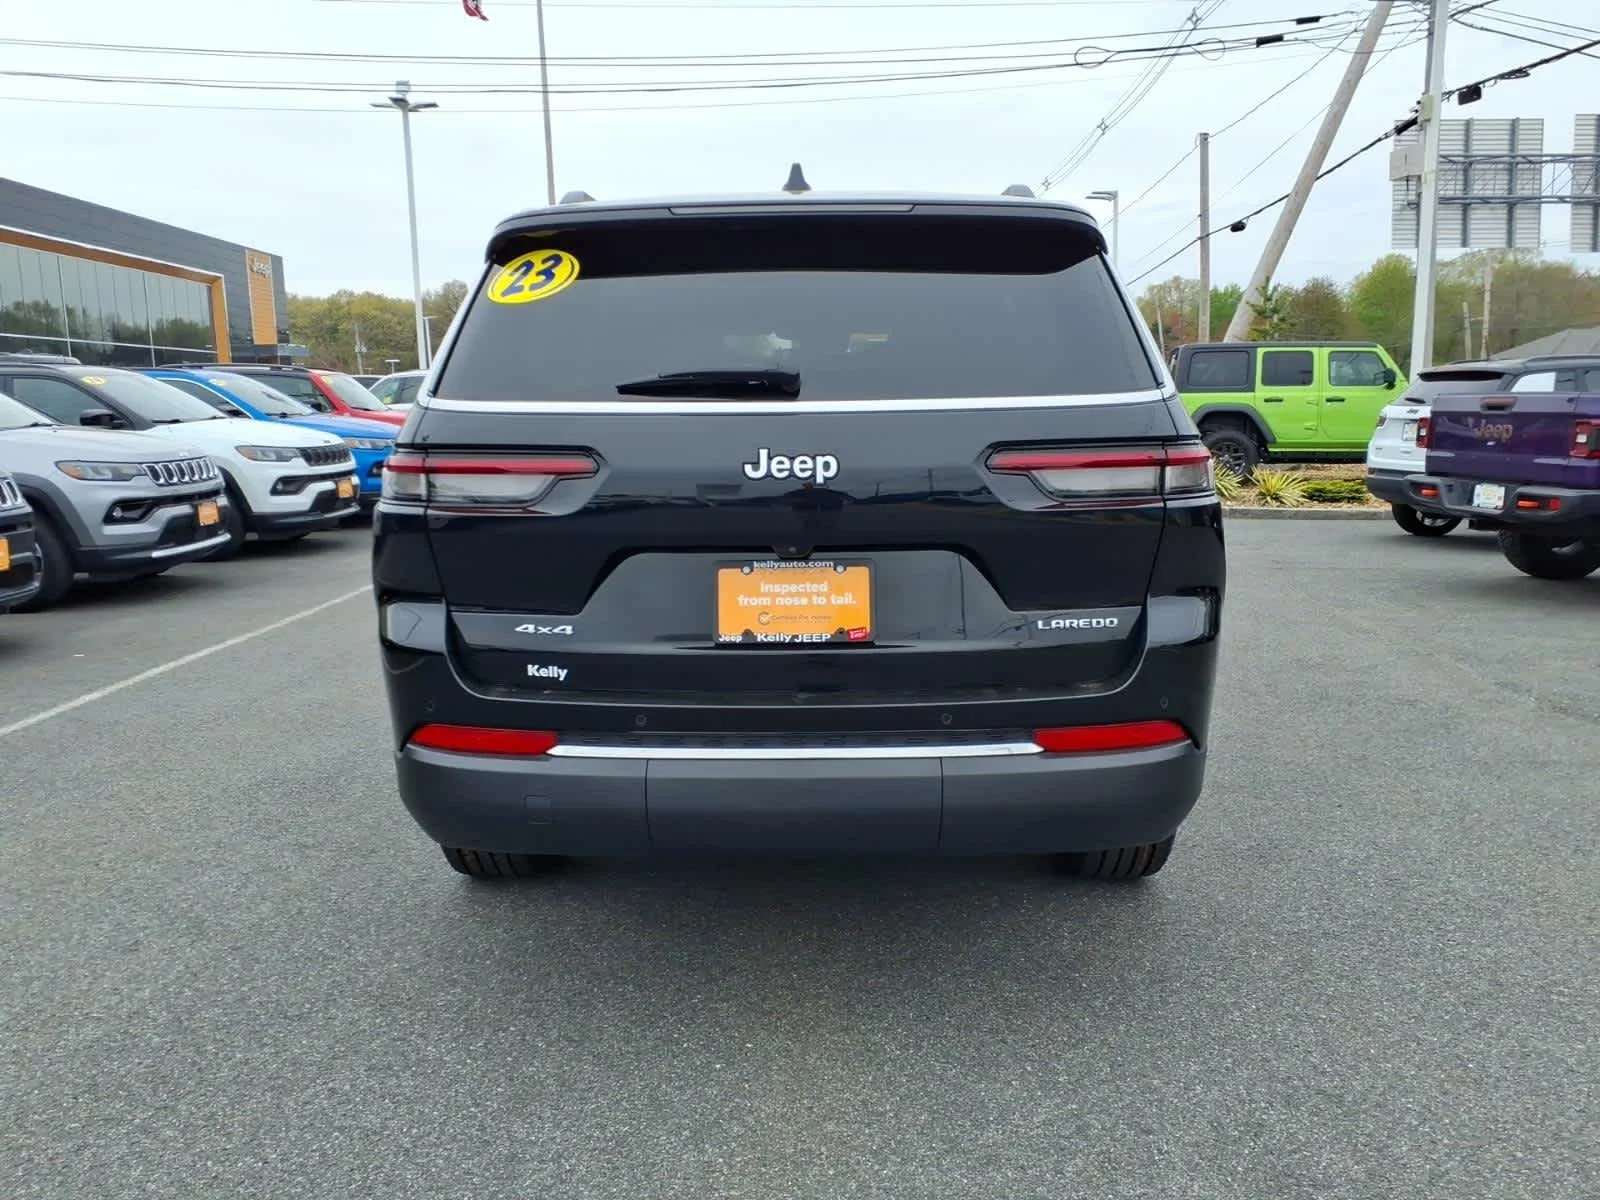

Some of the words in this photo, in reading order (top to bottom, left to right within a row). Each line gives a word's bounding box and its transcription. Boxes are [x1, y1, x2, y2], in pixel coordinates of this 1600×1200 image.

[501, 254, 563, 297] 23
[1472, 418, 1512, 442] Jeep
[743, 448, 839, 484] Jeep
[753, 560, 834, 569] kellyauto.com
[737, 594, 771, 606] from
[775, 596, 808, 606] nose
[812, 594, 827, 606] to
[831, 592, 857, 605] tail.
[514, 623, 574, 635] 4x4
[1037, 617, 1118, 630] LAREDO
[718, 633, 743, 643] Jeep
[757, 633, 792, 643] Kelly
[794, 633, 831, 643] JEEP
[527, 664, 568, 681] Kelly
